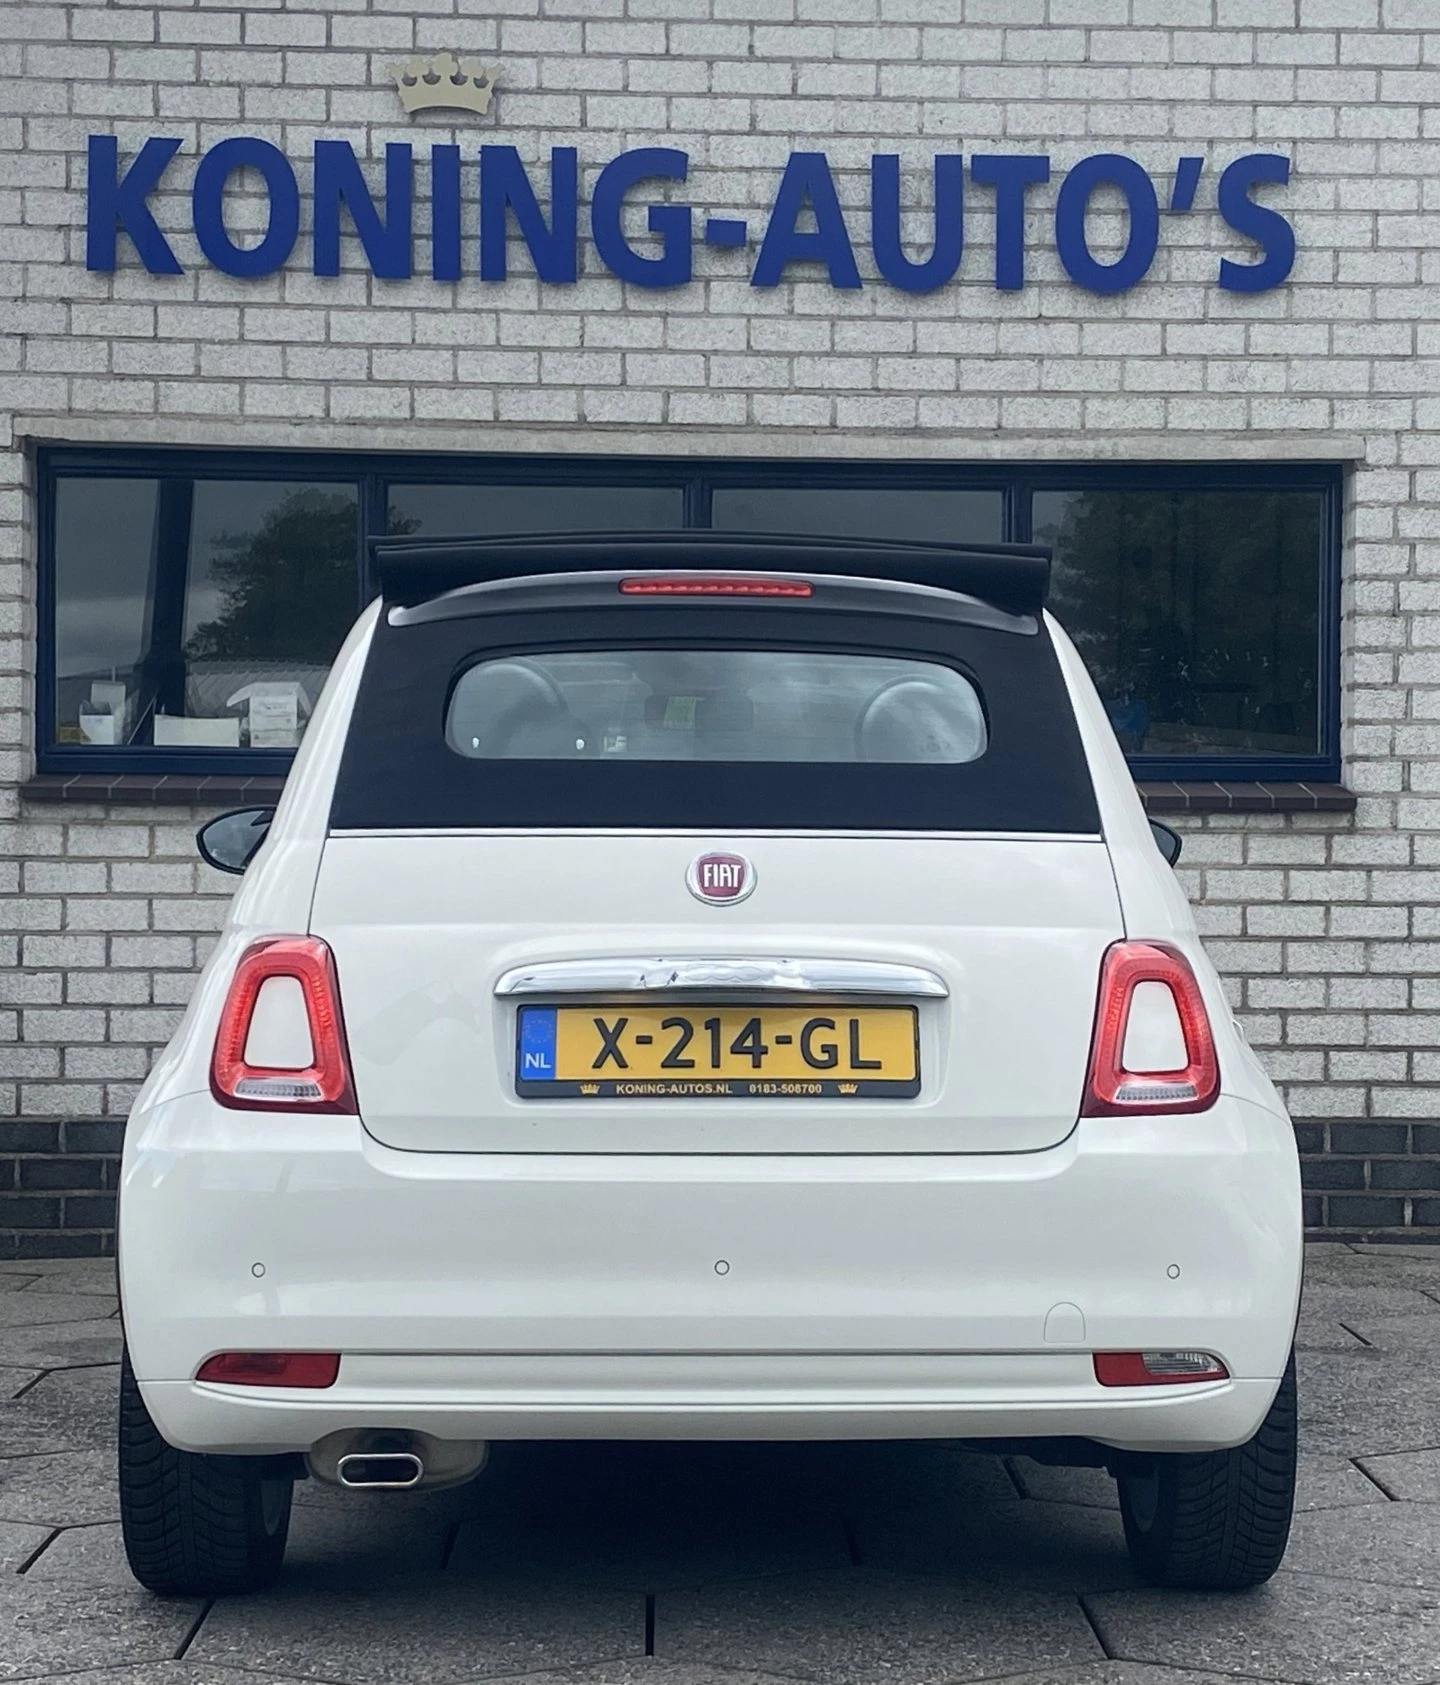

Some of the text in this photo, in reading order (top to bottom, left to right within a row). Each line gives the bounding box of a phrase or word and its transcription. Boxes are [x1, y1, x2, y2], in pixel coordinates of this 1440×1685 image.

[86, 135, 1296, 293] KONING-AUTO'S
[703, 864, 741, 887] FIAT
[591, 1017, 882, 1069] X-214-GL
[525, 1053, 551, 1068] NL
[616, 1083, 733, 1095] KONING-AUTOS.NL
